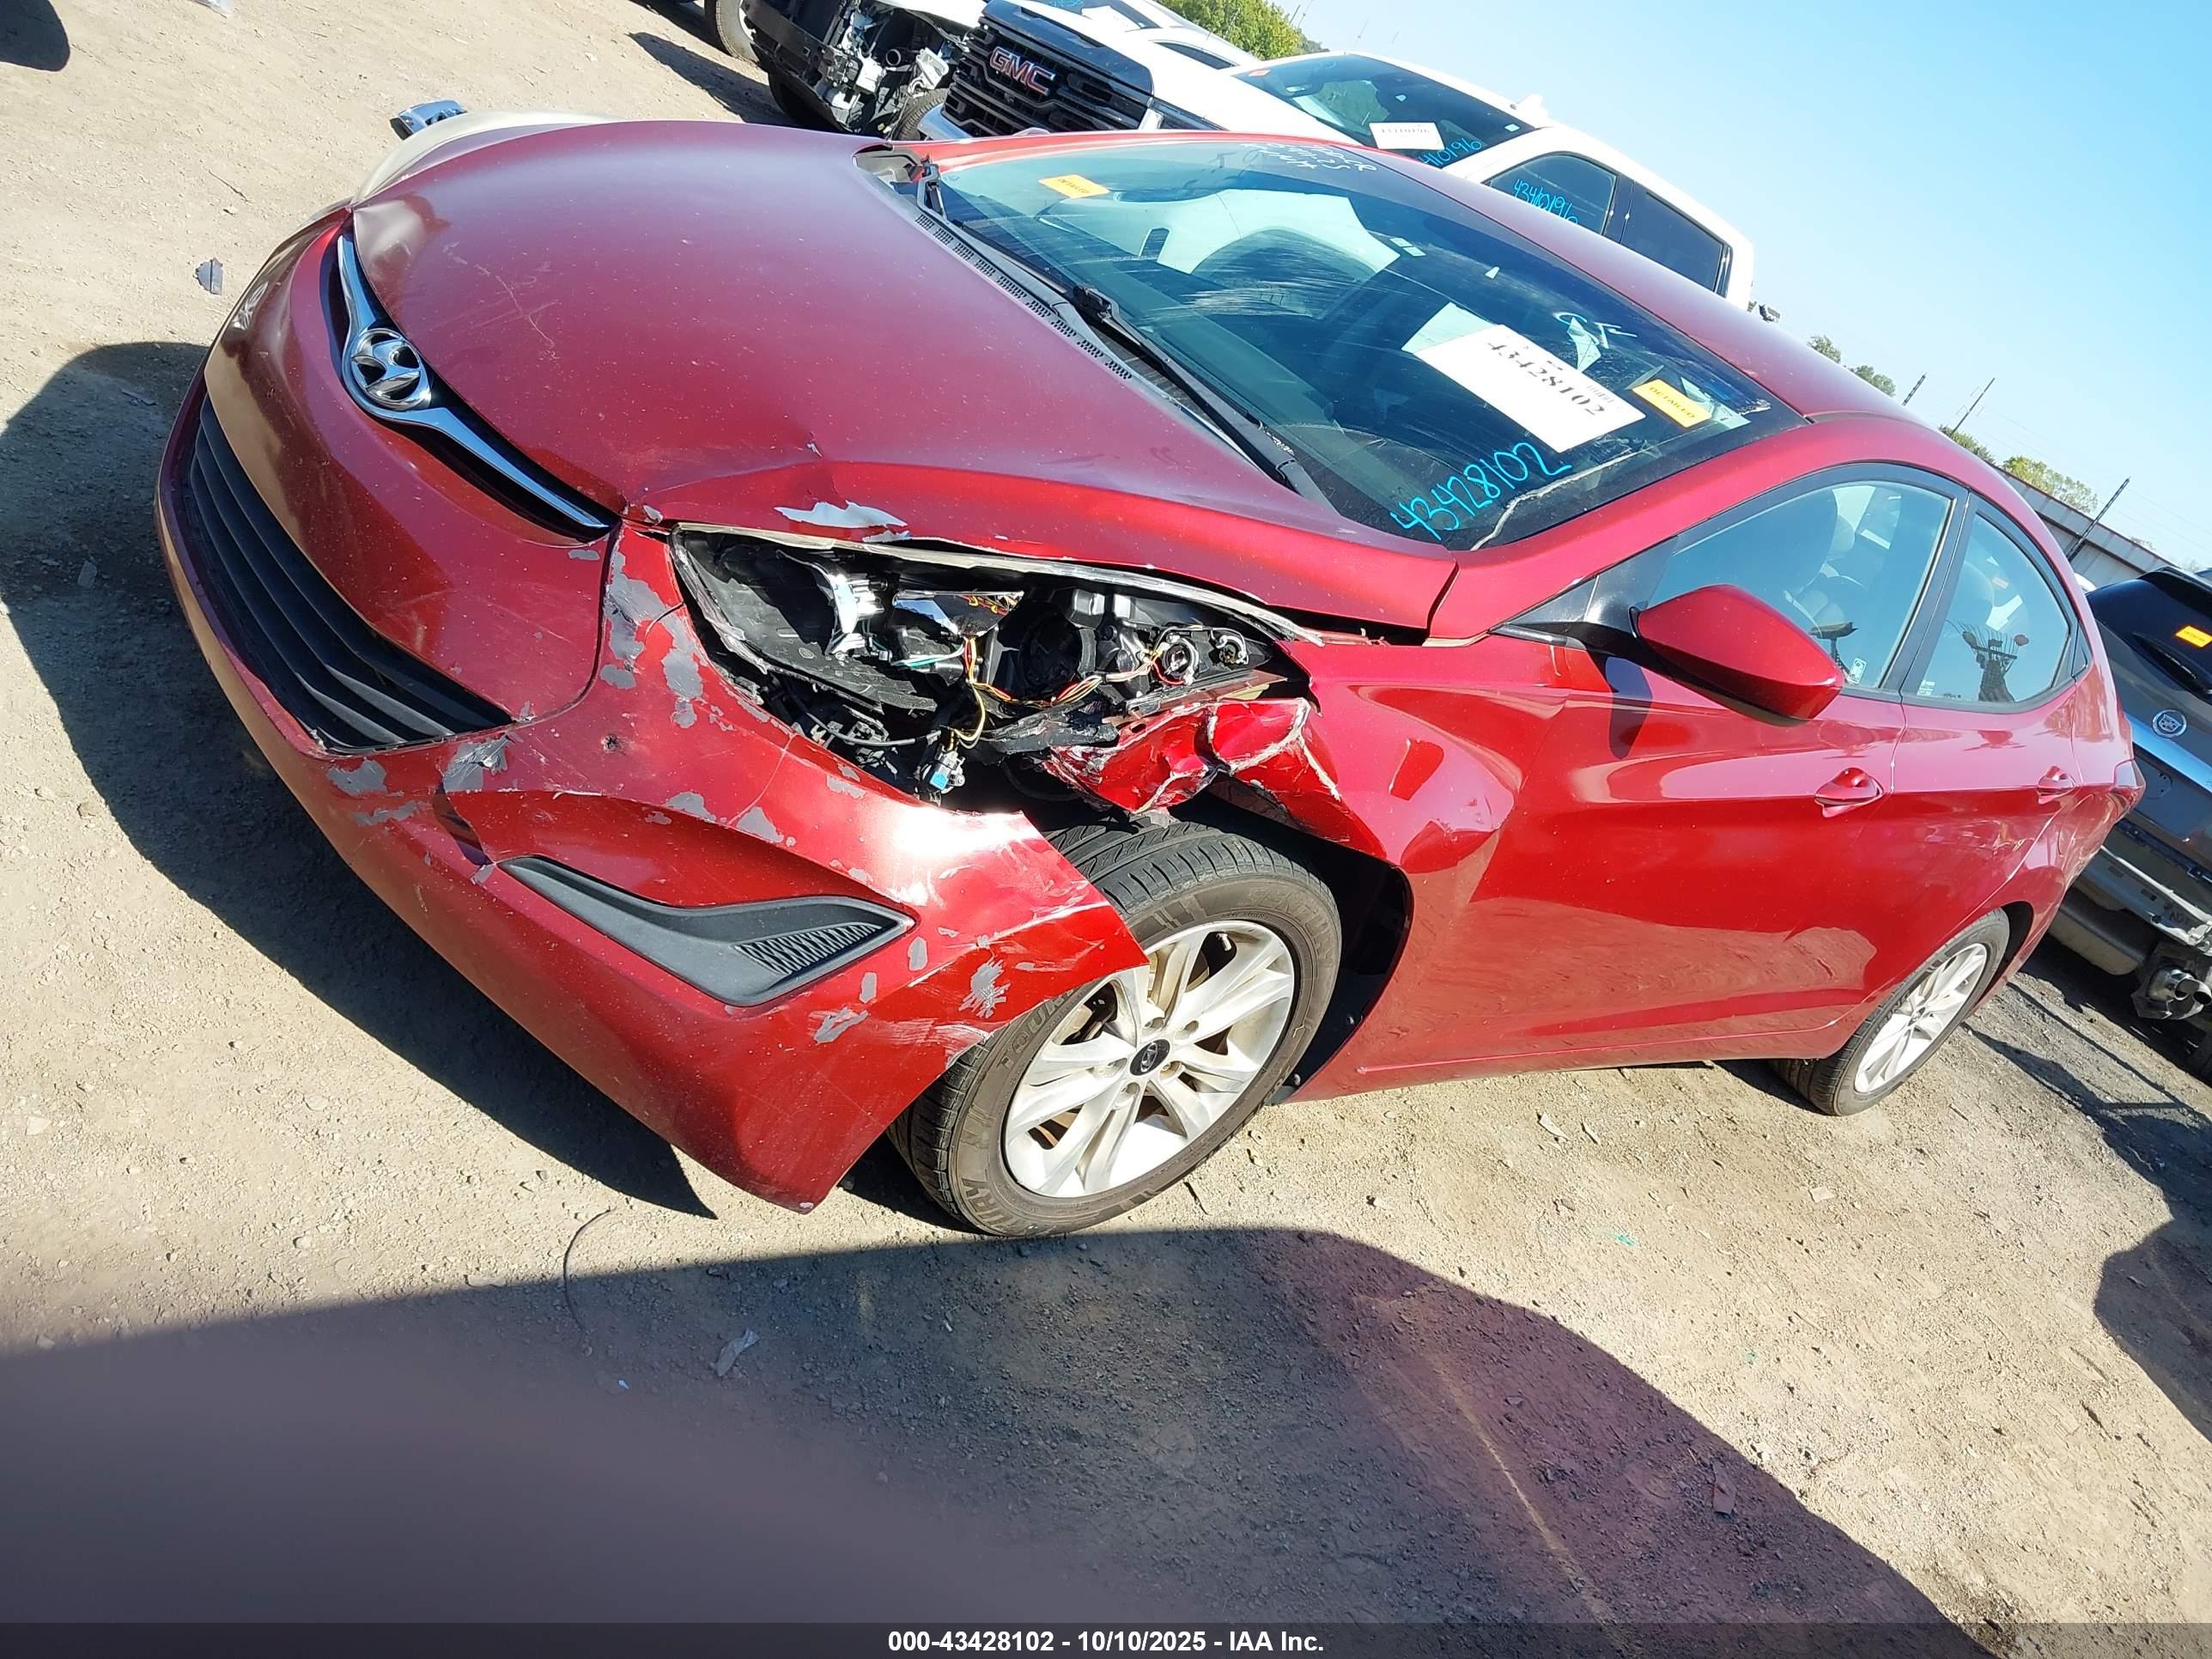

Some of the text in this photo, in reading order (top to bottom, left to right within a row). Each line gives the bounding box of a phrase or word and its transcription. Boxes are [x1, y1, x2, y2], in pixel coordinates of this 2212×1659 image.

[989, 46, 1055, 96] GMC
[1487, 342, 1605, 416] 43428102
[1389, 441, 1572, 542] 43428102
